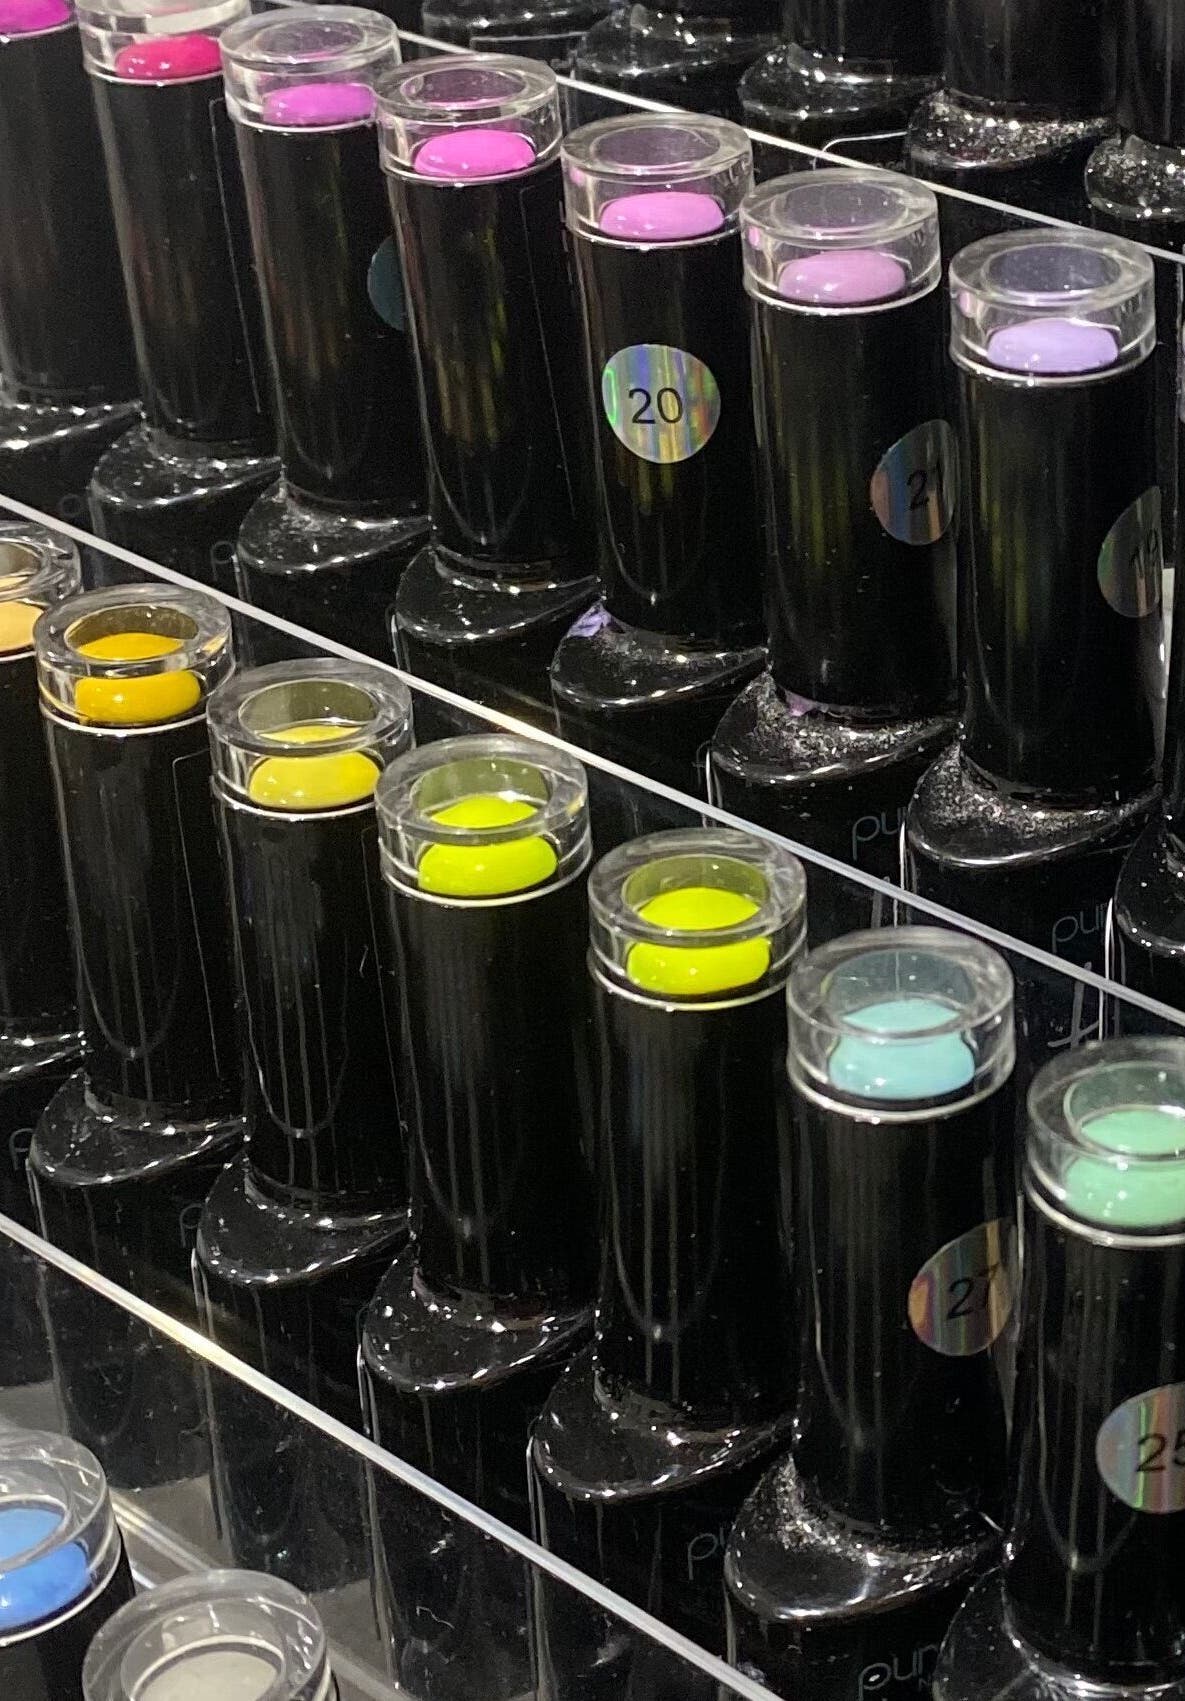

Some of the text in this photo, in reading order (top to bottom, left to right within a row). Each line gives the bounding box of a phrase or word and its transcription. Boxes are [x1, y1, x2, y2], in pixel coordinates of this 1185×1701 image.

[628, 387, 684, 424] 20
[946, 1261, 1000, 1319] 27
[857, 1643, 938, 1701] pur
